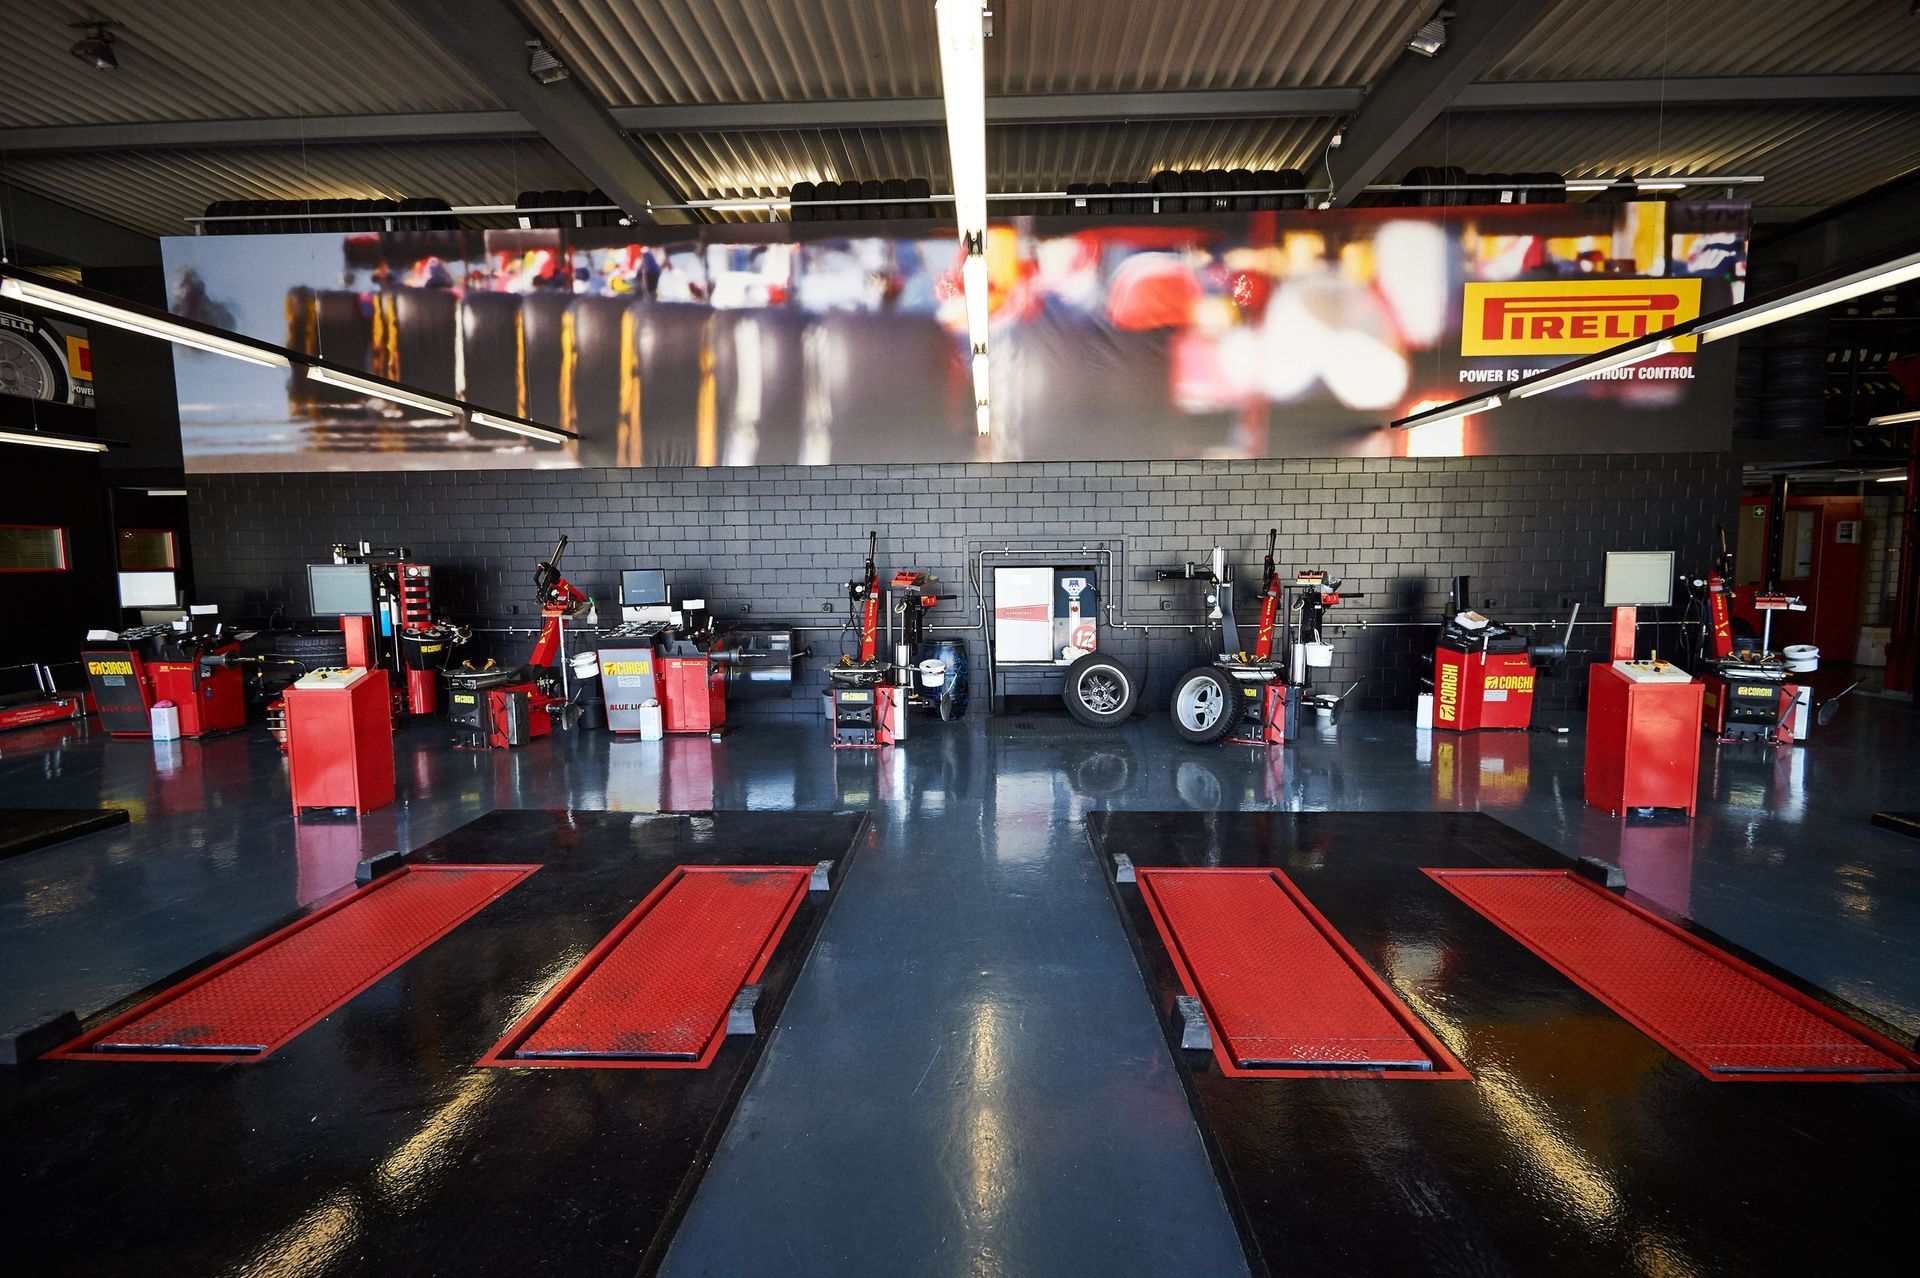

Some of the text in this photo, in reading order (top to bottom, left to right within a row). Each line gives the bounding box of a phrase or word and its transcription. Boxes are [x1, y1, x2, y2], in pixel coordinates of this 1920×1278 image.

[0, 312, 34, 333] ELLI
[1482, 295, 1680, 340] PIRELLI
[1459, 369, 1503, 382] POWER
[1506, 369, 1520, 382] IS
[1638, 366, 1695, 379] CONTROL
[1076, 630, 1096, 649] 12
[100, 661, 134, 675] CORGHI
[616, 661, 650, 675] CORGHI
[1440, 663, 1458, 705] CORGHI
[1499, 676, 1534, 689] CORGHI
[610, 703, 629, 711] BLUE
